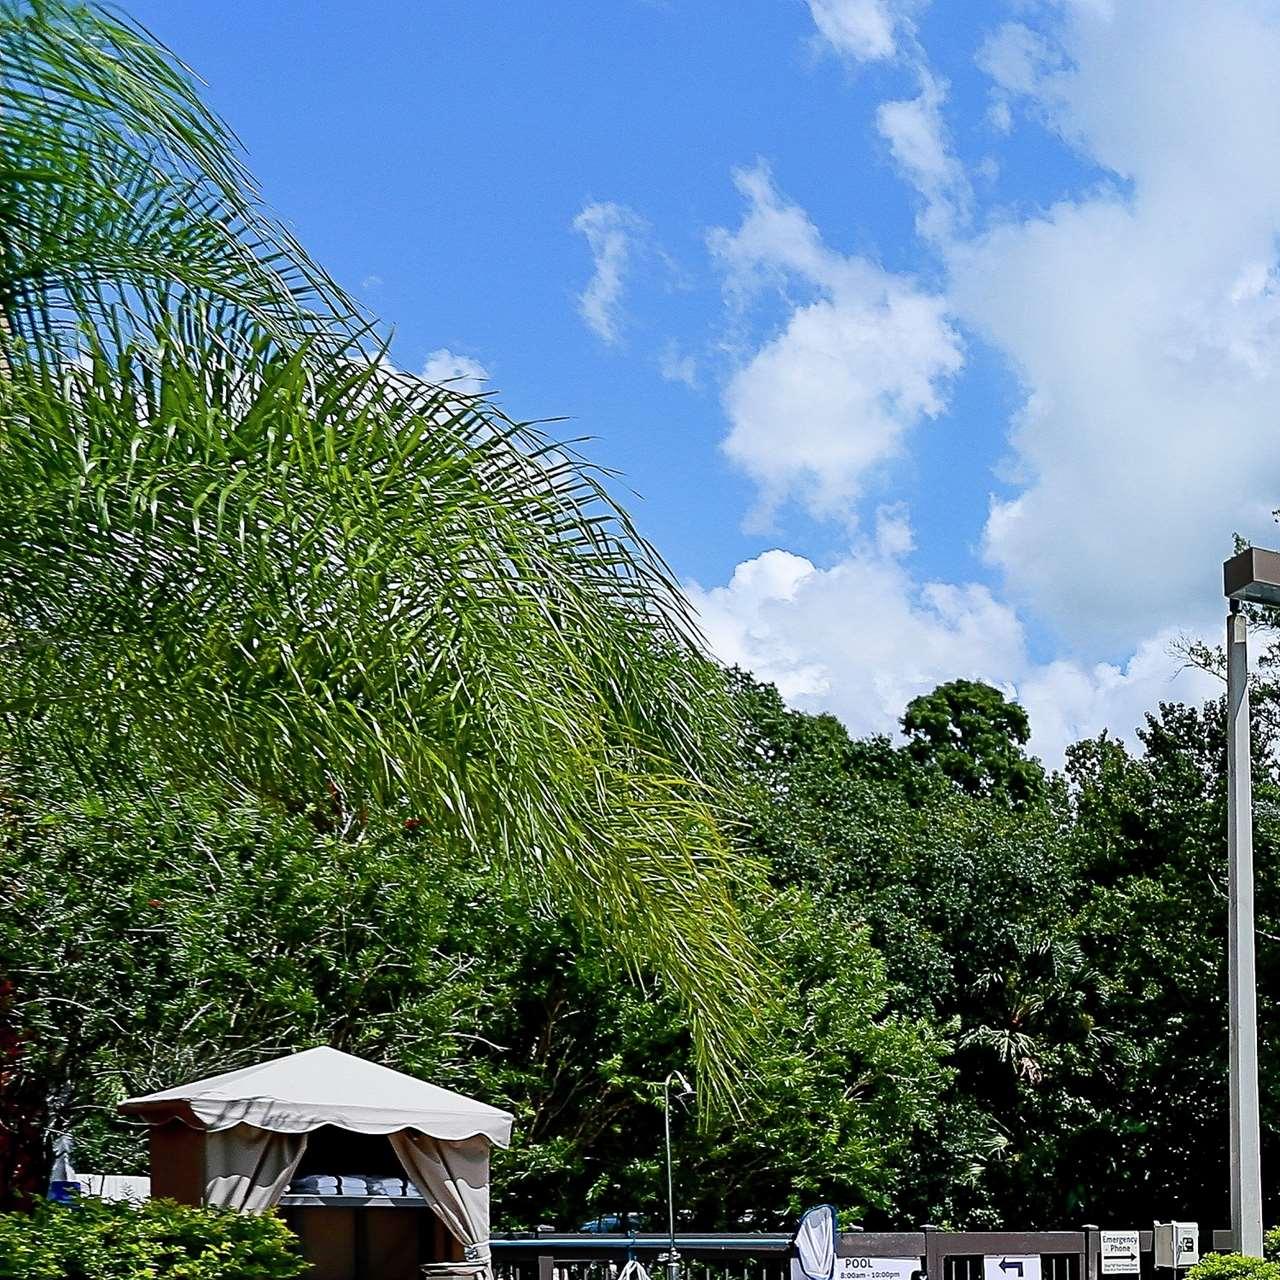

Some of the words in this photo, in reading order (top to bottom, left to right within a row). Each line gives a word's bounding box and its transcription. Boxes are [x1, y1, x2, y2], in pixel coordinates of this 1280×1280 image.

[1103, 1236, 1137, 1244] Emergency
[1110, 1244, 1131, 1252] Phone
[845, 1259, 873, 1269] POOL
[872, 1271, 900, 1279] 10:00pm
